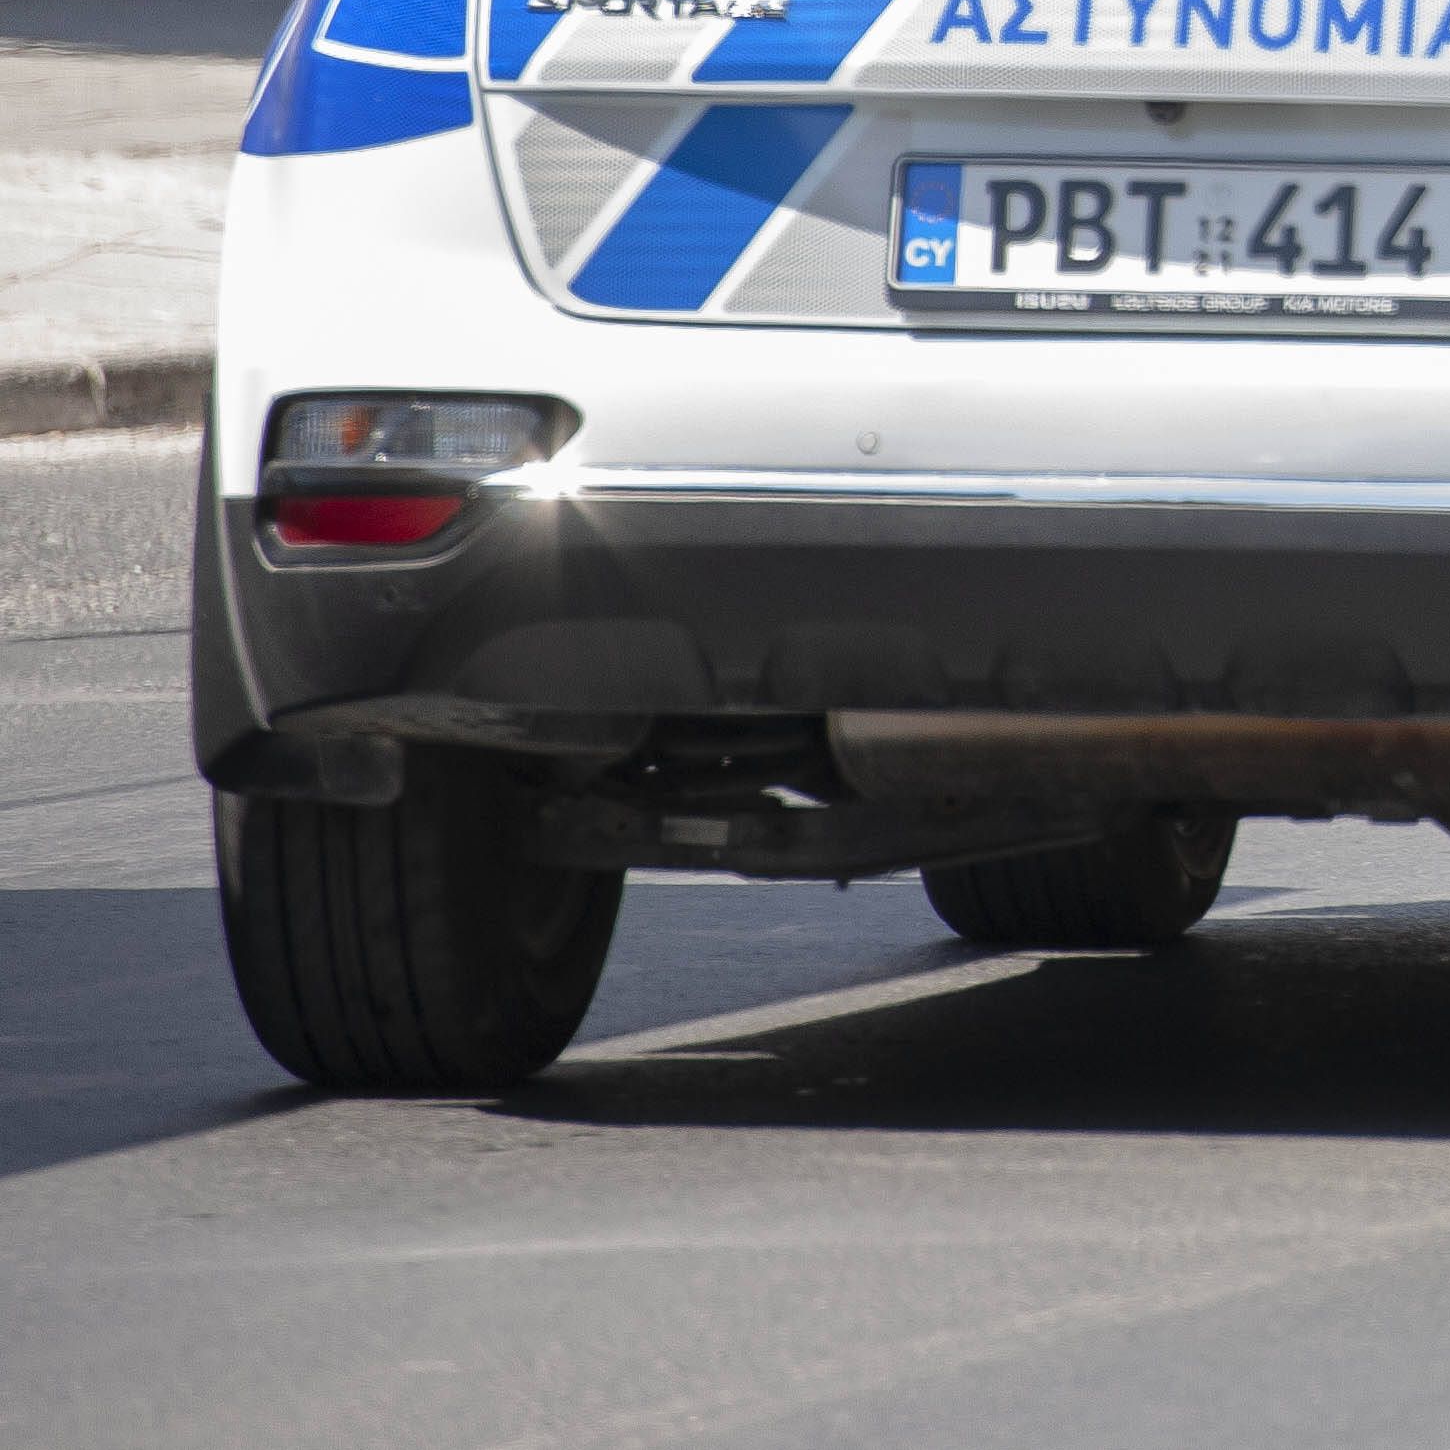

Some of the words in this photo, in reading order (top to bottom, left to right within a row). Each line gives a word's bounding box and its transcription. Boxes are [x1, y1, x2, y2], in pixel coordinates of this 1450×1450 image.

[985, 179, 1188, 276] PBT
[1245, 183, 1433, 279] 414
[904, 237, 951, 269] CY
[1015, 293, 1091, 310] ISUZU
[1202, 295, 1269, 314] GROUP
[1282, 296, 1315, 314] KIA
